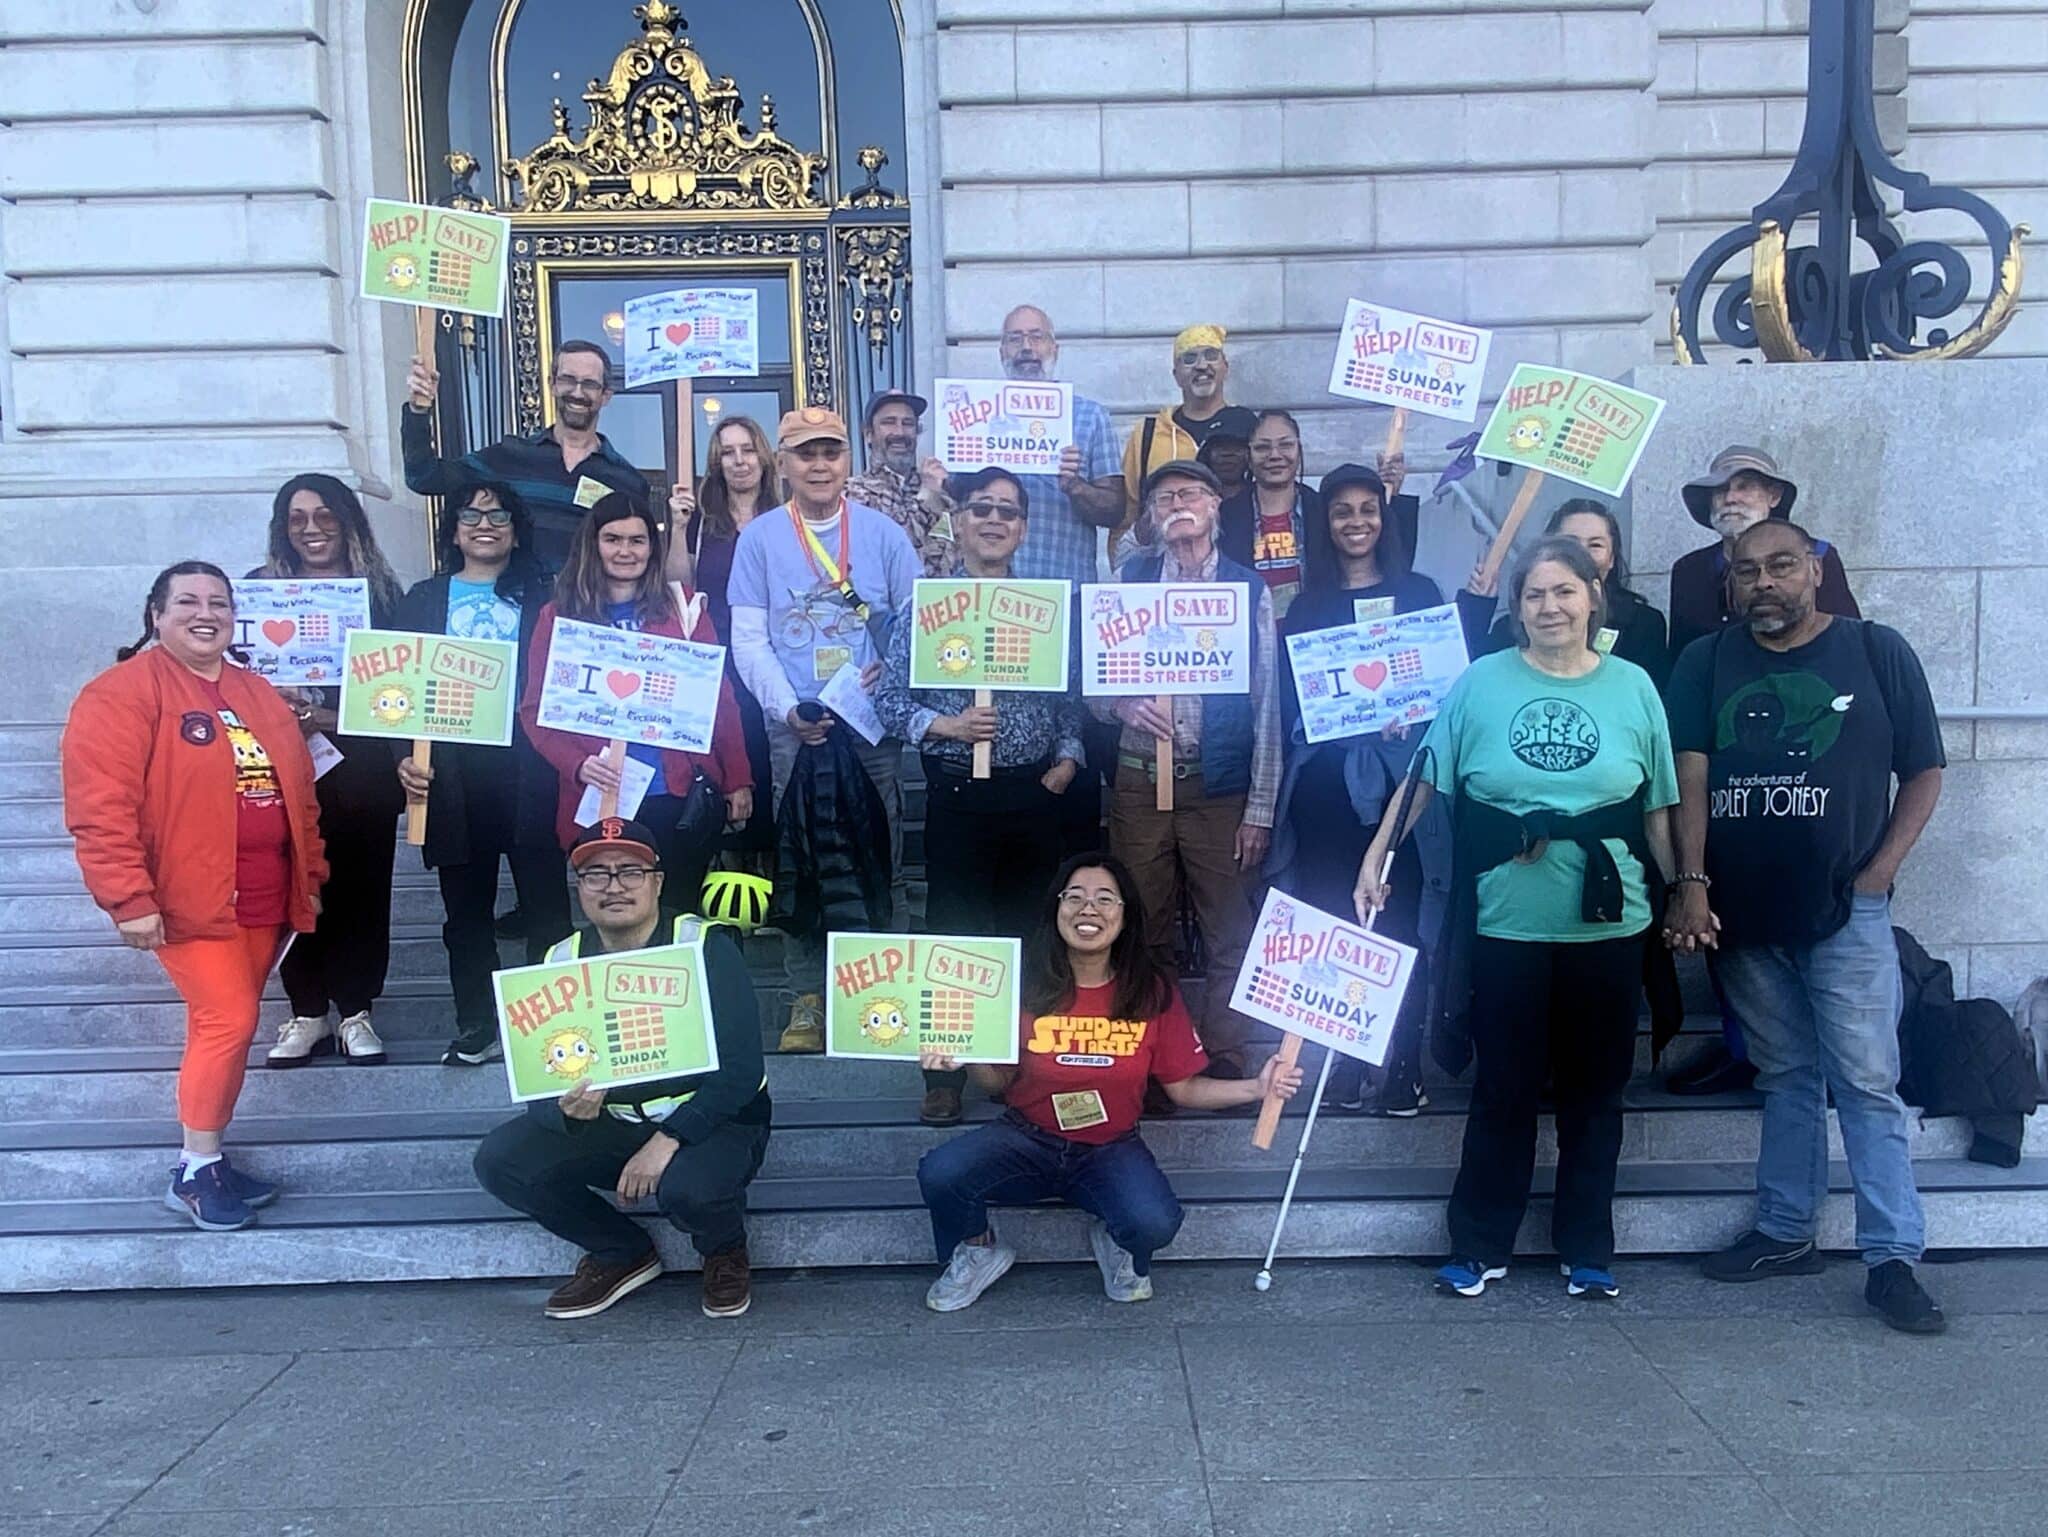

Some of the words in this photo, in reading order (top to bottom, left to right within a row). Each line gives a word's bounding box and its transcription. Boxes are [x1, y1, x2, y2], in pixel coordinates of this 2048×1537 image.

[370, 210, 428, 252] HELP!
[442, 225, 487, 254] SAVE
[427, 284, 469, 297] SUNDAY
[647, 326, 661, 352] I
[1354, 327, 1412, 359] HELP!
[1421, 330, 1471, 355] SAVE
[1384, 383, 1450, 408] STREETS
[1387, 367, 1466, 396] SUNDAY
[1507, 376, 1578, 413] HELP!
[948, 393, 1000, 433] HELP!
[1010, 393, 1056, 411] SAVE
[1586, 395, 1633, 431] SAVE
[986, 437, 1059, 451] SUNDAY
[986, 453, 1048, 465] STREETS
[1547, 449, 1594, 469] SUNDAY
[918, 583, 982, 636] HELP!
[997, 597, 1049, 624] SAVE
[1173, 598, 1229, 616] SAVE
[233, 619, 256, 648] I
[1097, 600, 1161, 649] HELP!
[351, 637, 423, 684] HELP!
[441, 652, 496, 681] SAVE
[983, 664, 1029, 674] SUNDAY
[1143, 651, 1233, 667] SUNDAY
[578, 663, 602, 695] I
[1144, 669, 1220, 683] STREETS
[1327, 668, 1350, 699] I
[424, 716, 472, 727] SUNDAY
[1794, 771, 1807, 785] of
[1762, 786, 1831, 817] JONESY
[1263, 931, 1327, 966] HELP!
[1334, 939, 1392, 976] SAVE
[835, 940, 915, 998] HELP!
[936, 955, 994, 987] SAVE
[506, 962, 594, 1037] HELP!
[615, 973, 680, 997] SAVE
[1290, 983, 1378, 1028] SUNDAY
[1284, 1003, 1358, 1042] STREETS
[919, 1033, 974, 1043] SUNDAY
[610, 1048, 668, 1067] SUNDAY
